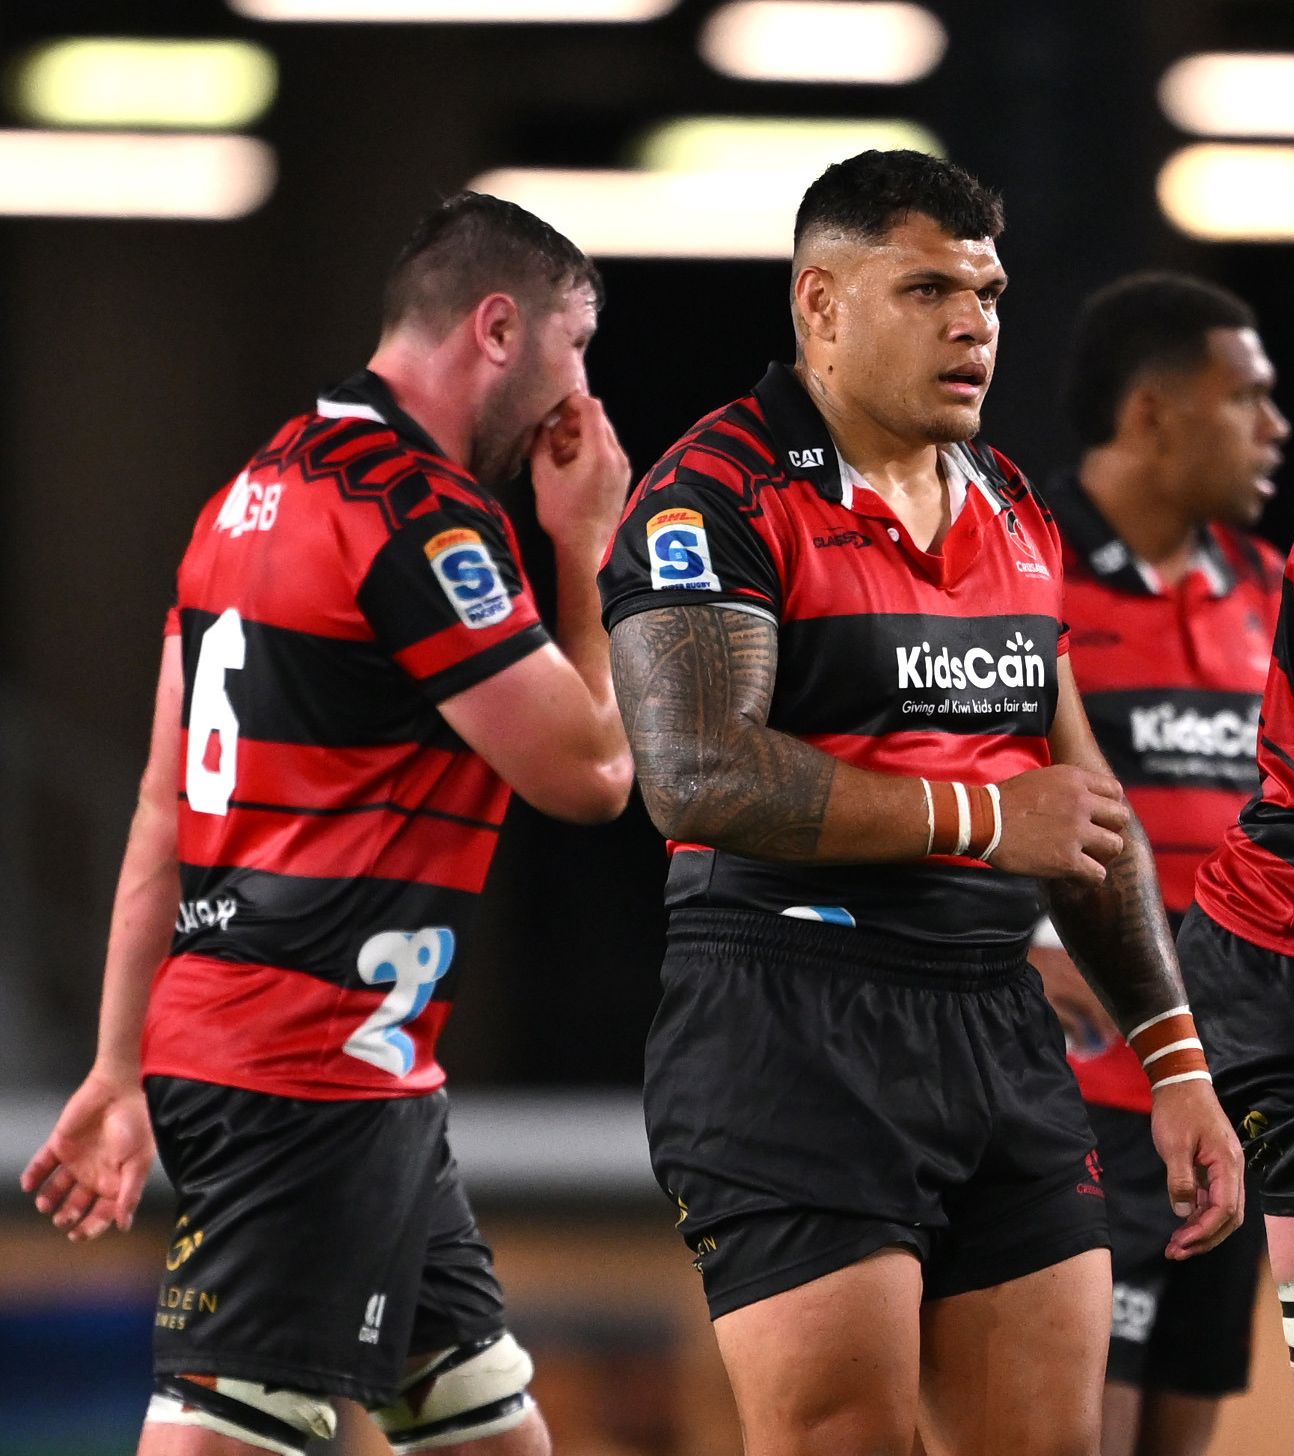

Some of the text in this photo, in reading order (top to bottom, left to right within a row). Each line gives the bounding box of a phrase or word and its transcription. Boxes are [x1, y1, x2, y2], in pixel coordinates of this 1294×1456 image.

[788, 448, 825, 468] CAT
[895, 631, 1045, 690] KidsCan
[185, 607, 245, 817] 6
[902, 697, 1038, 716] Giving all Kiwi kids a fair start
